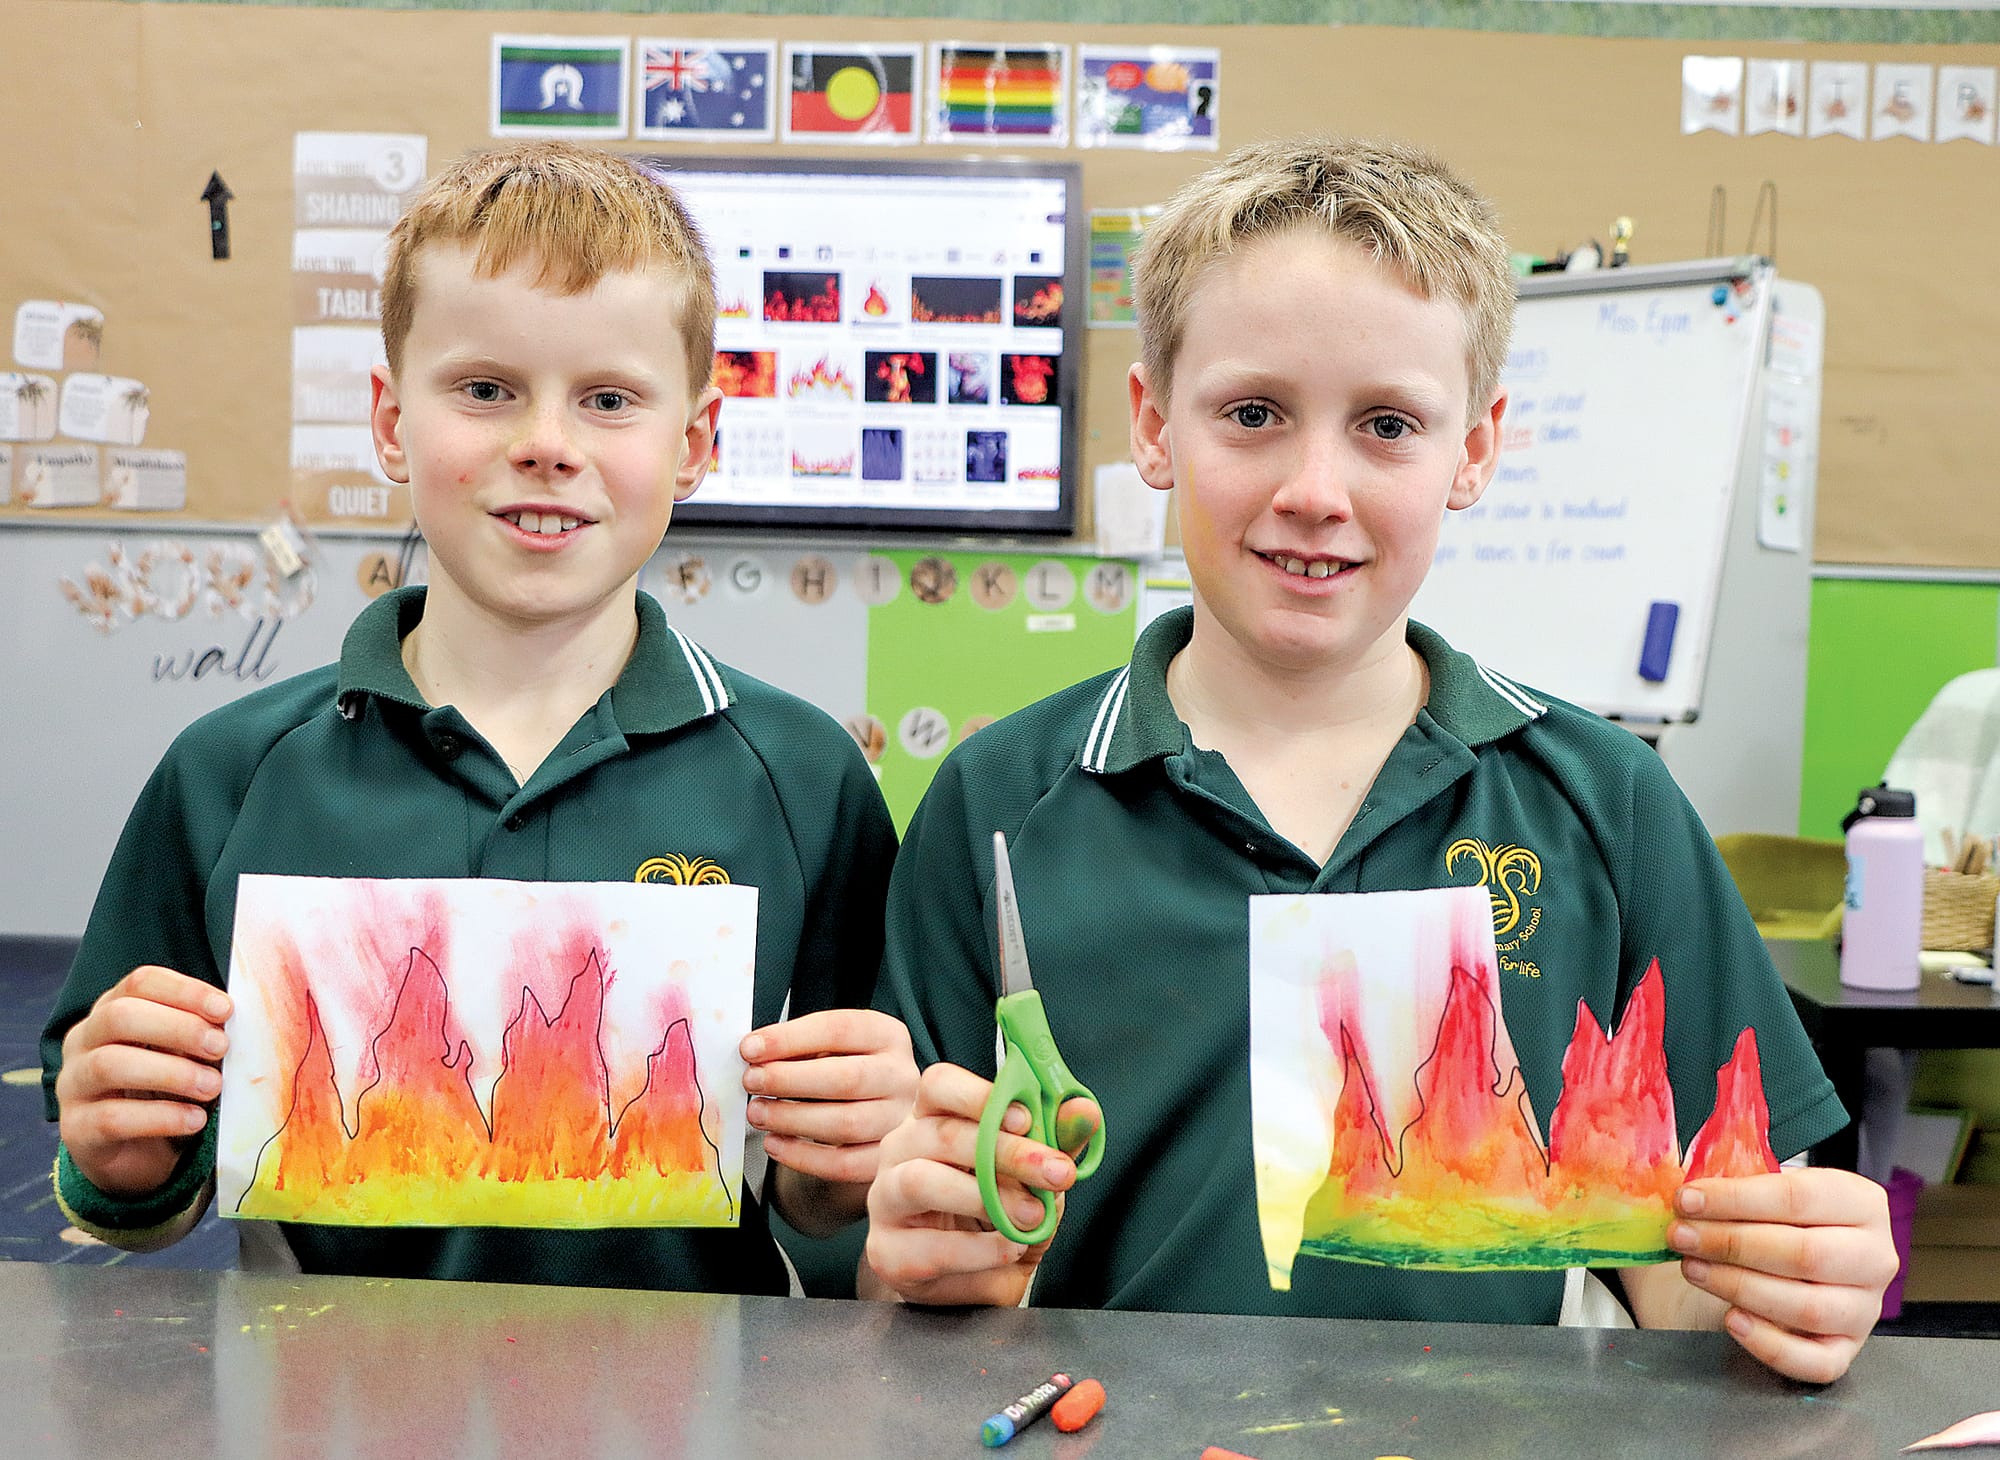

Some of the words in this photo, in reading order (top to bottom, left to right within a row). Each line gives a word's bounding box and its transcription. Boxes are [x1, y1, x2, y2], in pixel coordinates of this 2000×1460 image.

[385, 152, 405, 182] 3
[306, 193, 400, 223] SHARING
[37, 453, 92, 467] Empathy
[329, 485, 390, 517] QUIET
[369, 556, 393, 587] A
[733, 560, 761, 593] G
[802, 566, 825, 596] H
[980, 568, 1005, 597] K
[1041, 568, 1059, 598] L
[1097, 567, 1125, 598] M
[154, 617, 284, 681] wall
[911, 711, 947, 747] W
[1495, 938, 1520, 951] mary
[1518, 906, 1542, 941] School
[1499, 955, 1518, 970] for
[1518, 960, 1541, 978] life
